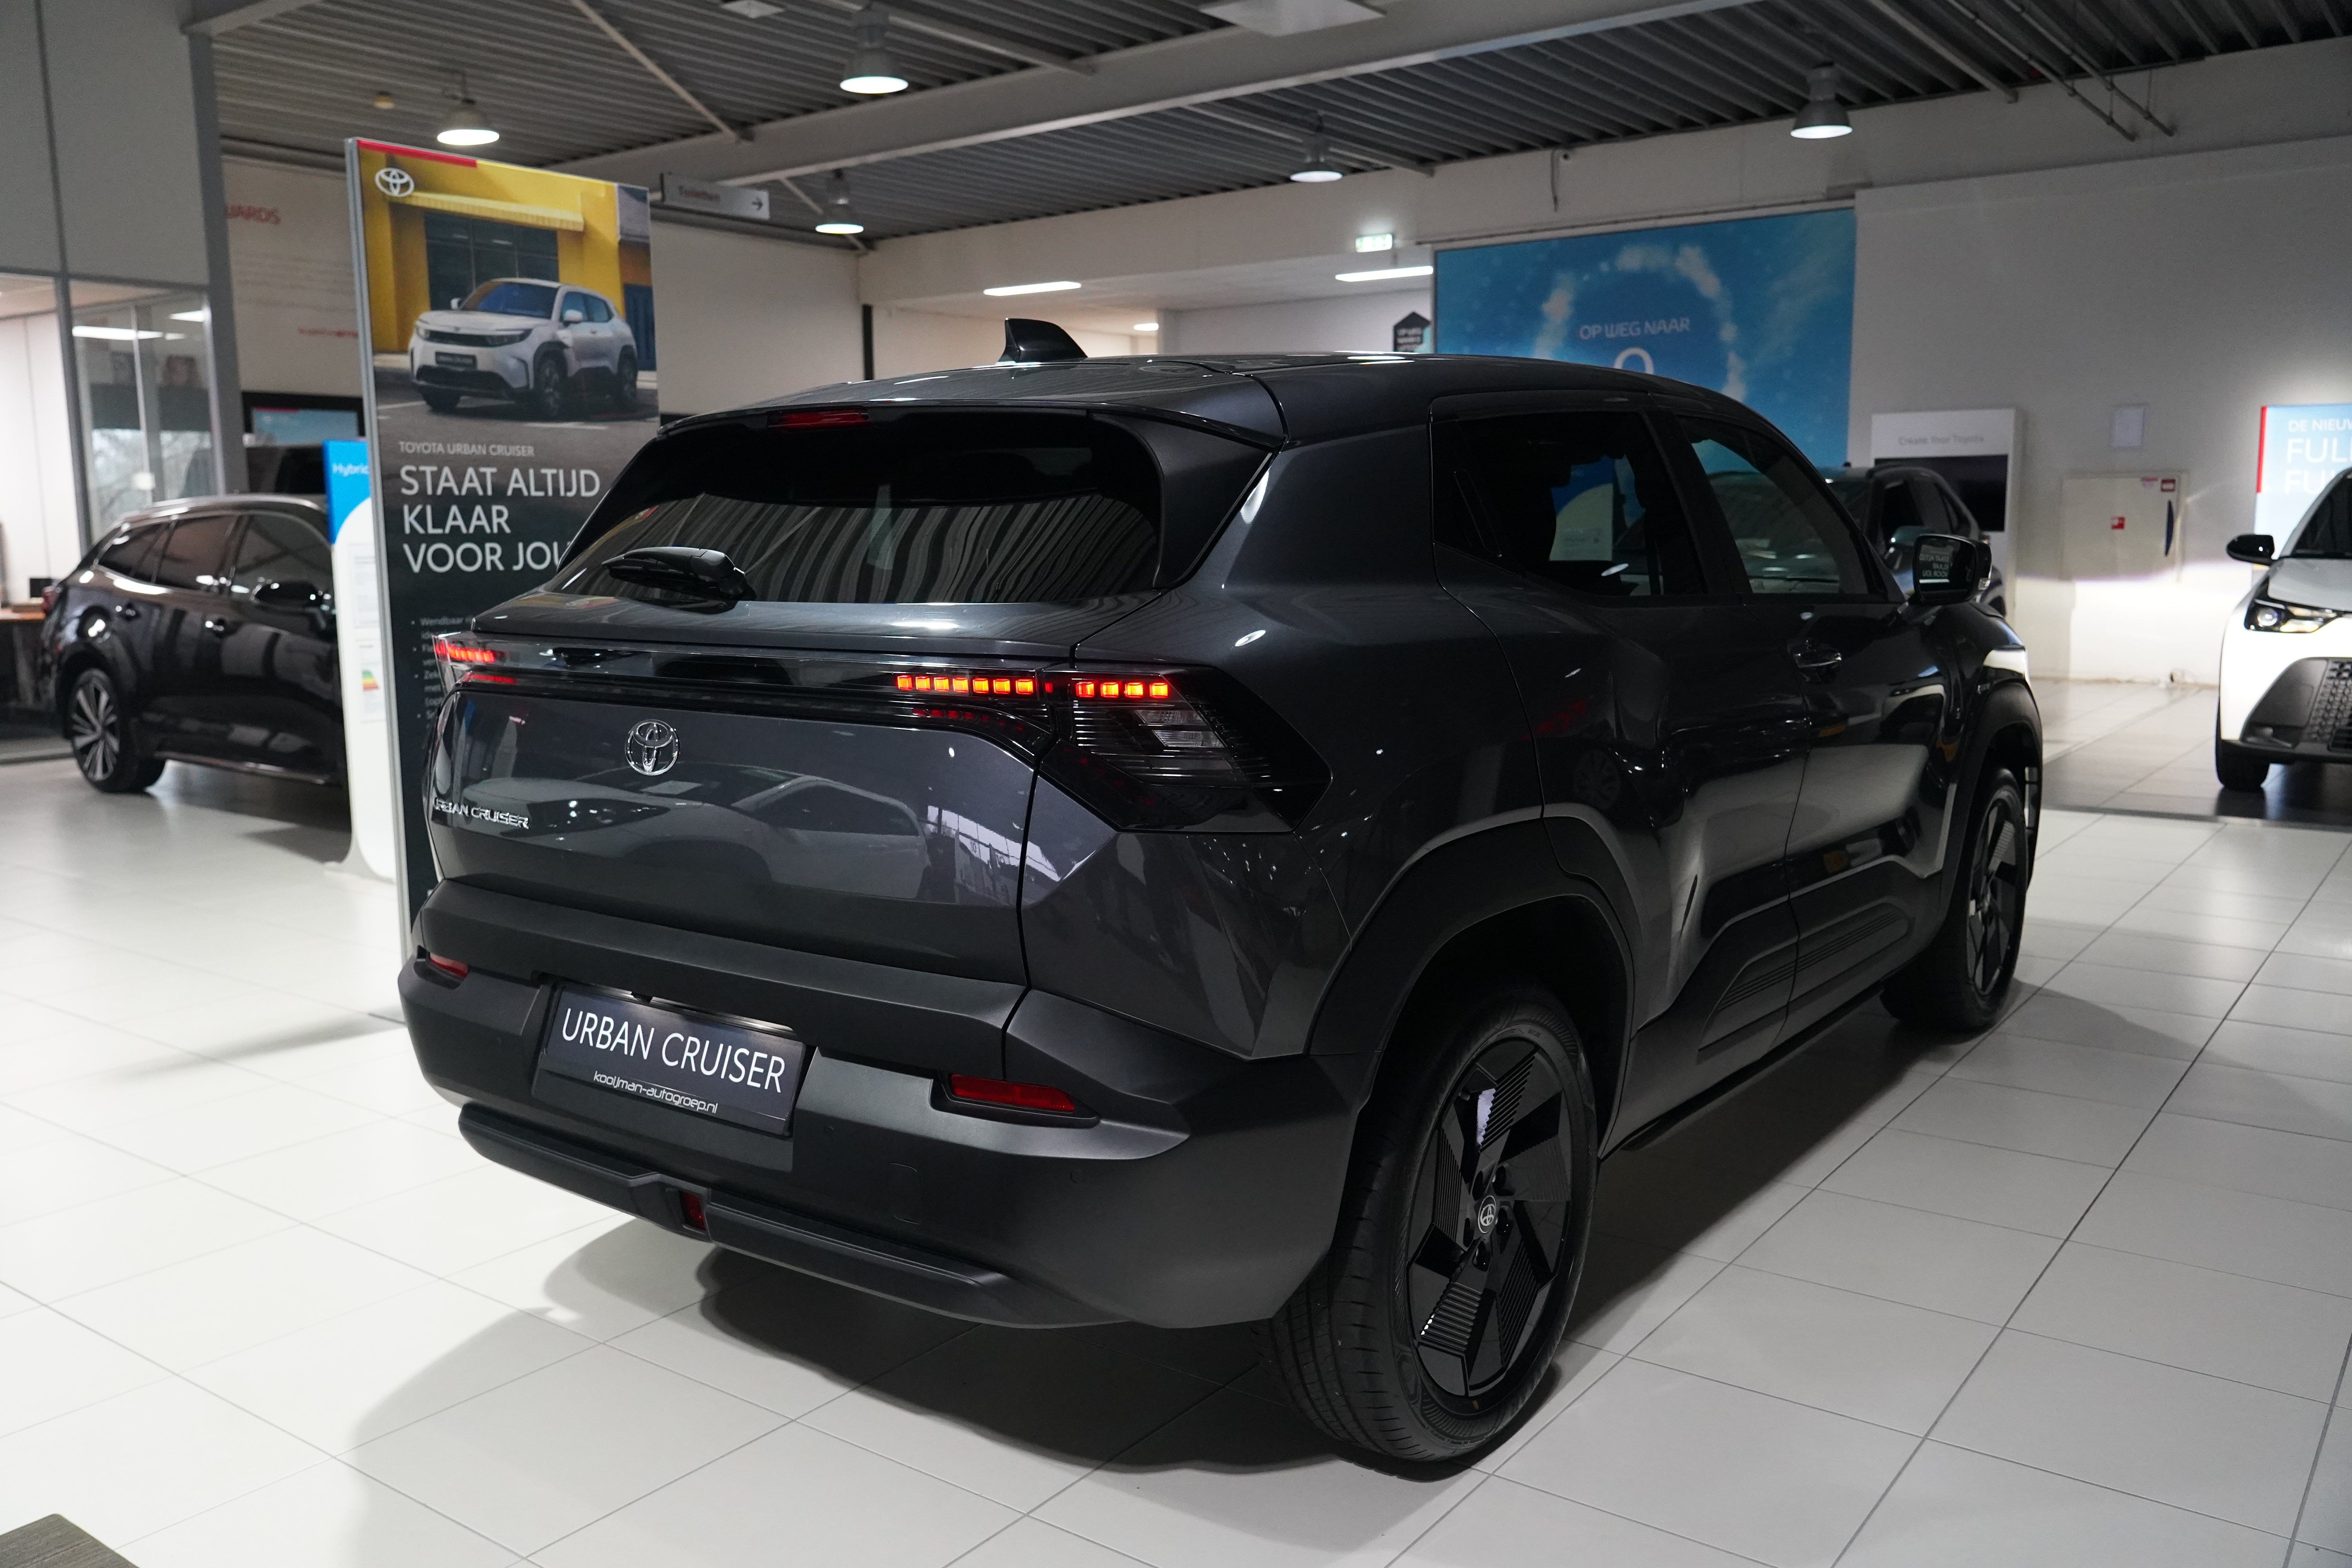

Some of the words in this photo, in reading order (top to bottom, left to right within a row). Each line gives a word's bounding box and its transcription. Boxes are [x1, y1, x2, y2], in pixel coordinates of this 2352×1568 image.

[1579, 324, 1602, 339] OP
[1605, 321, 1641, 338] WEG
[1644, 317, 1690, 335] NAAR
[2288, 419, 2307, 432] DE
[399, 441, 444, 454] TOYOTA
[447, 443, 486, 456] URBAN
[490, 444, 534, 457] CRUISER
[2287, 437, 2352, 463] FUL
[401, 465, 497, 496] STAAT
[507, 468, 600, 497] ALTIJD
[2285, 470, 2336, 494] FU
[404, 505, 511, 534] KLAAR
[403, 542, 504, 573] VOOR
[471, 807, 530, 829] CRUISER
[563, 1008, 654, 1060] URBAN
[662, 1033, 785, 1093] CRUISER
[593, 1071, 718, 1114] kooijman-autogroep.nl
